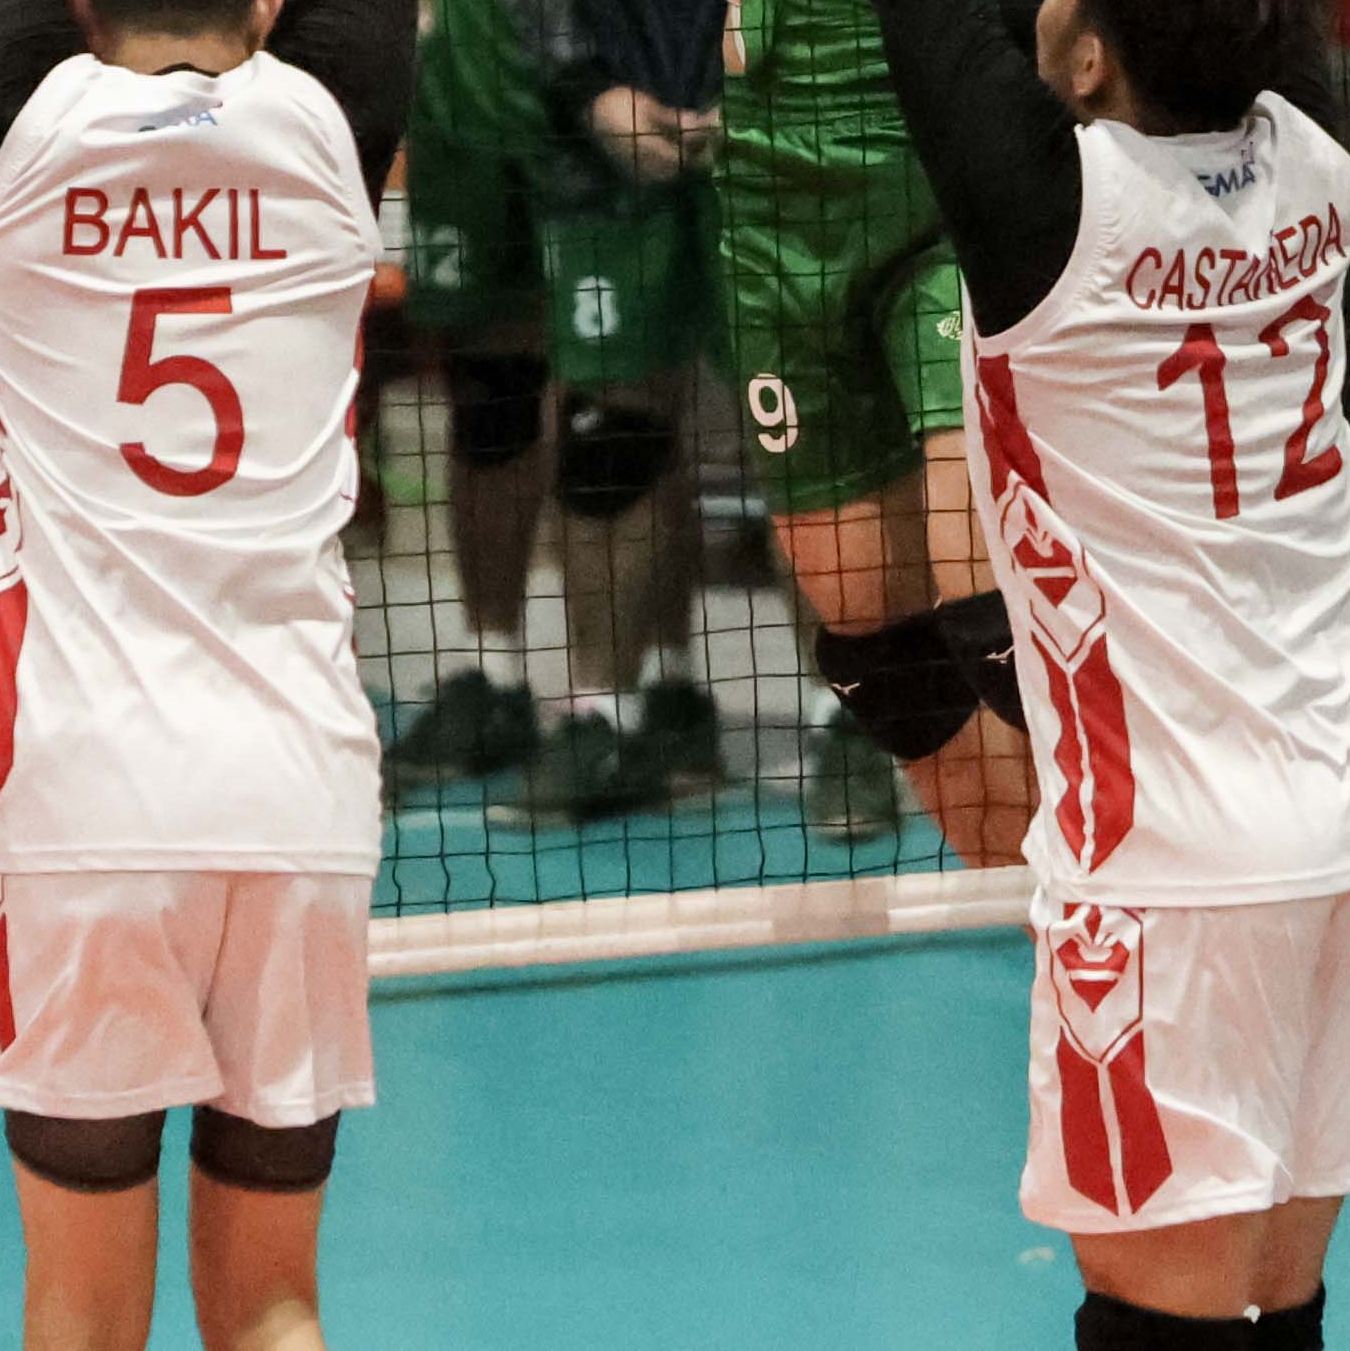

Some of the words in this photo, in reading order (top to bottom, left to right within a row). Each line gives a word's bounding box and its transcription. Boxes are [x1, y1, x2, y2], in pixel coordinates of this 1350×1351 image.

[61, 188, 287, 260] BAKIL
[116, 286, 245, 498] 5
[748, 373, 799, 453] 9
[1156, 293, 1343, 520] 12
